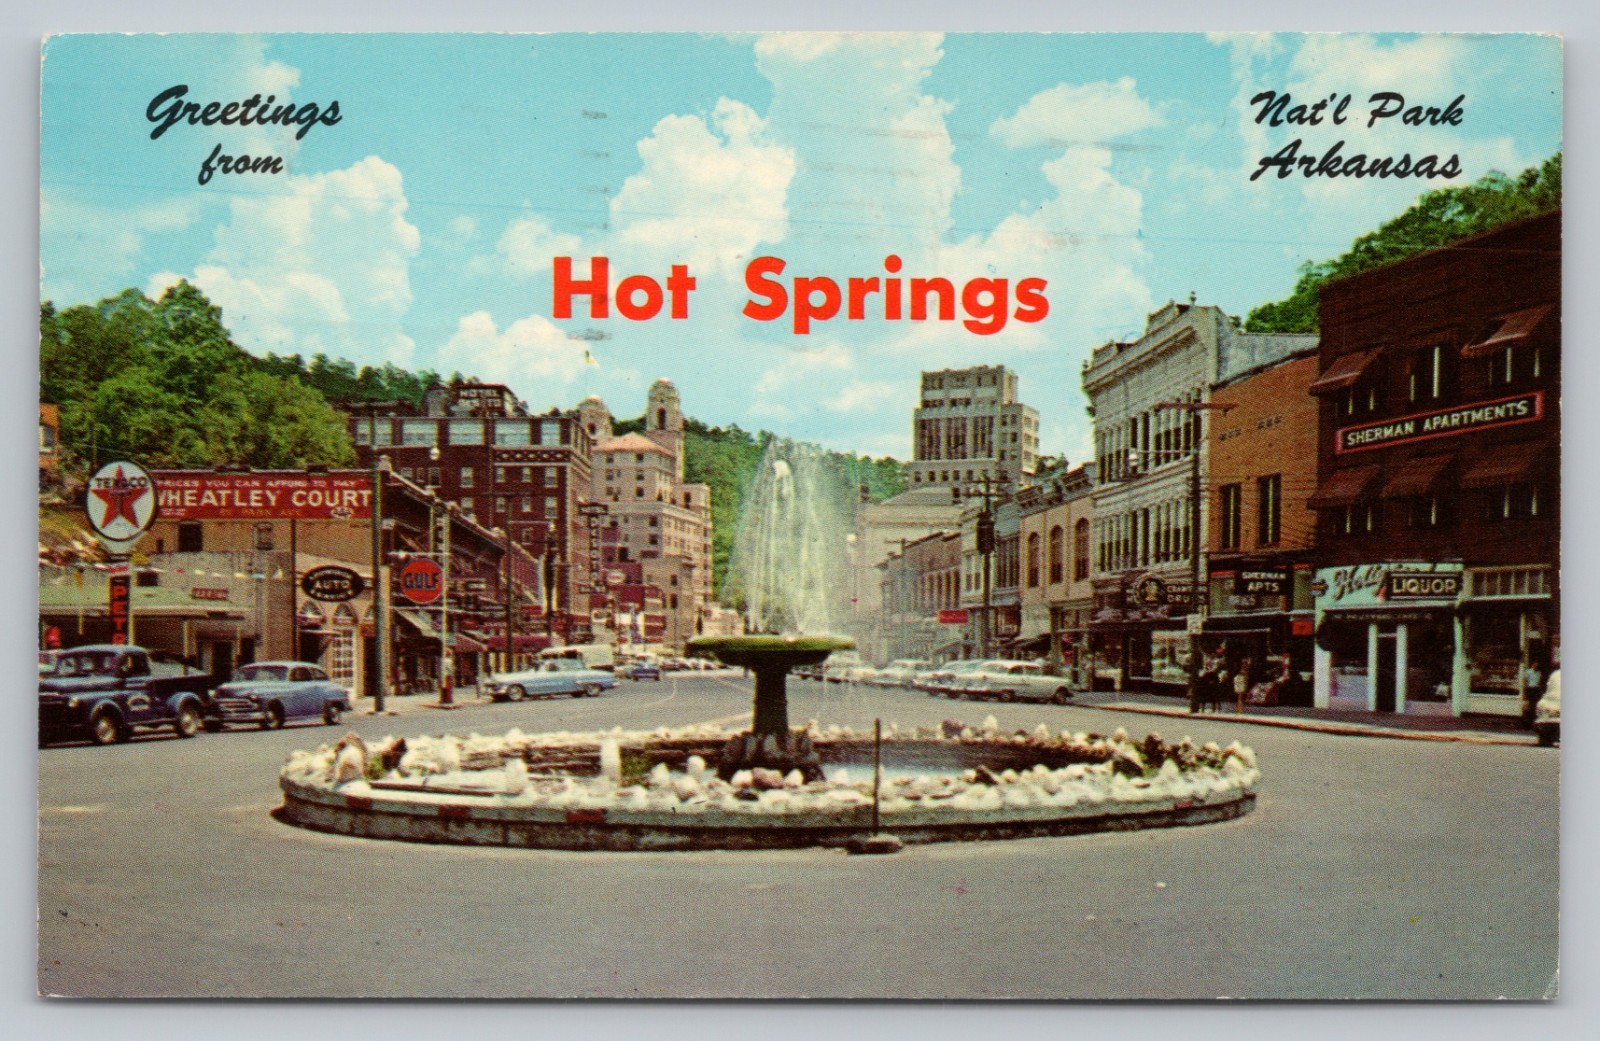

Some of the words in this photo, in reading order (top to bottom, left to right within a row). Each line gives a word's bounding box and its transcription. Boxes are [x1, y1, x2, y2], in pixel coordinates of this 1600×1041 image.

[1347, 420, 1415, 446] SHERMAN
[1423, 399, 1529, 433] APARTMENTS
[95, 476, 149, 488] TEXACO
[291, 489, 373, 507] COURT
[313, 580, 351, 590] AUTO
[404, 572, 440, 591] GULF
[1247, 581, 1280, 592] APTS
[1391, 578, 1458, 594] LIQUOR
